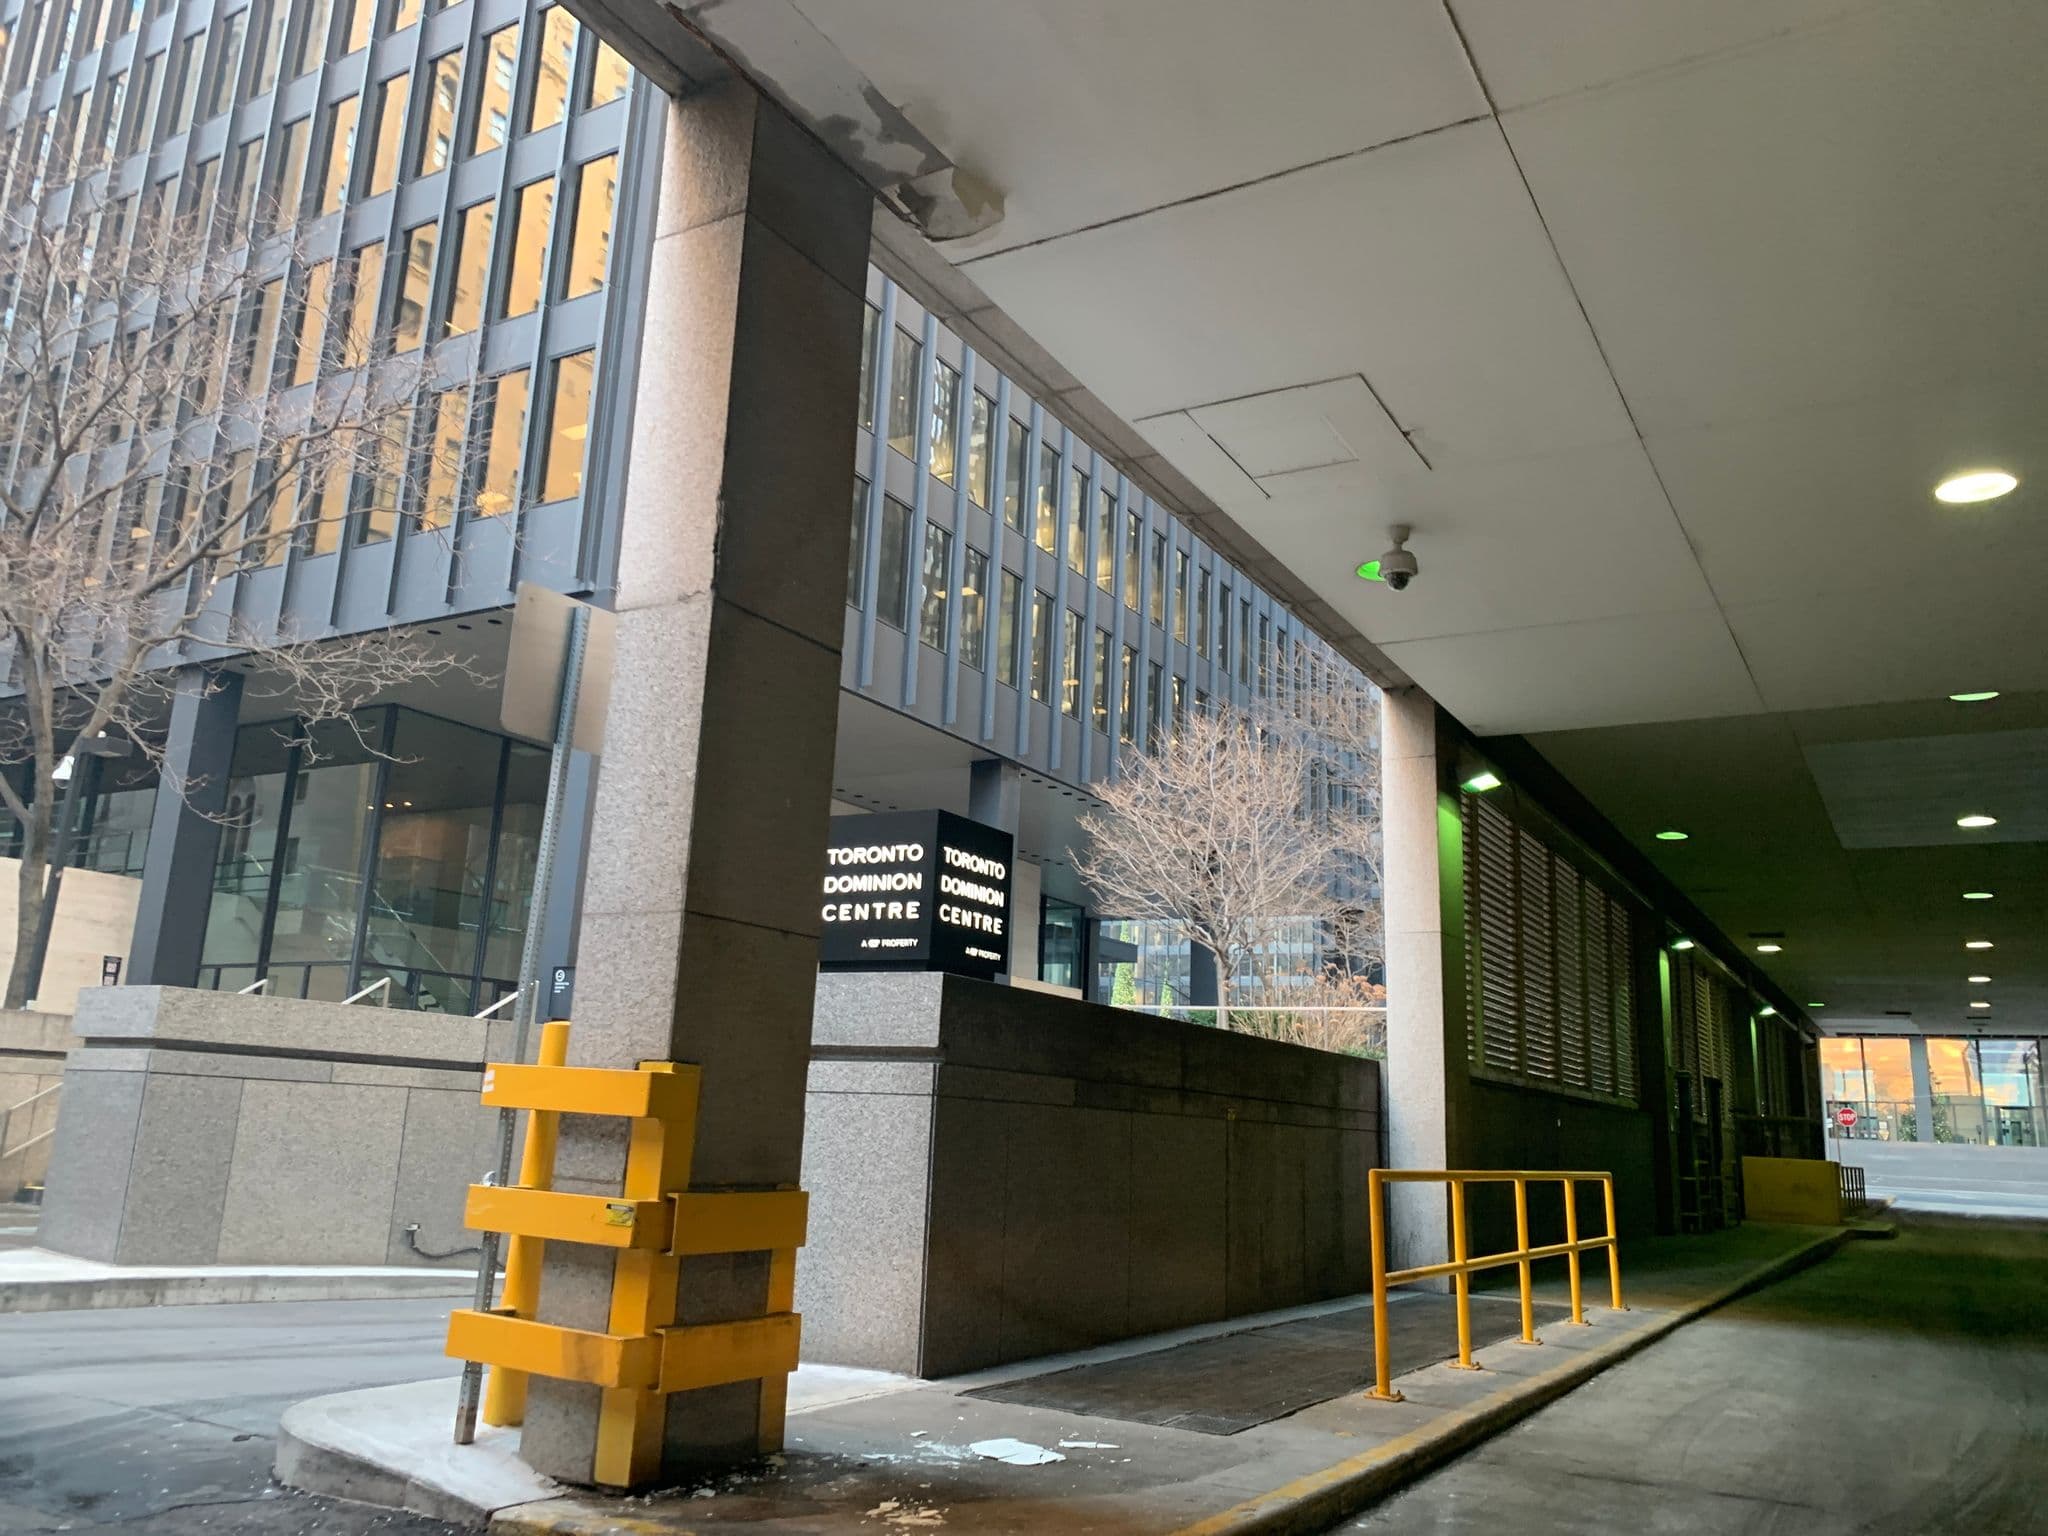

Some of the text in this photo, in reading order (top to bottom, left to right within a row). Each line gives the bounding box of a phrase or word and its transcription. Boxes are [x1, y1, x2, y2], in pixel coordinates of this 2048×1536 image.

[827, 843, 924, 865] TORONTO
[943, 846, 1005, 880] TORONTO
[823, 872, 922, 893] DOMINION
[940, 874, 1004, 907] DOMINION
[822, 901, 920, 921] CENTRE
[939, 903, 1003, 935] CENTRE
[881, 938, 918, 947] PROPERTY
[1838, 1113, 1856, 1121] STOP
